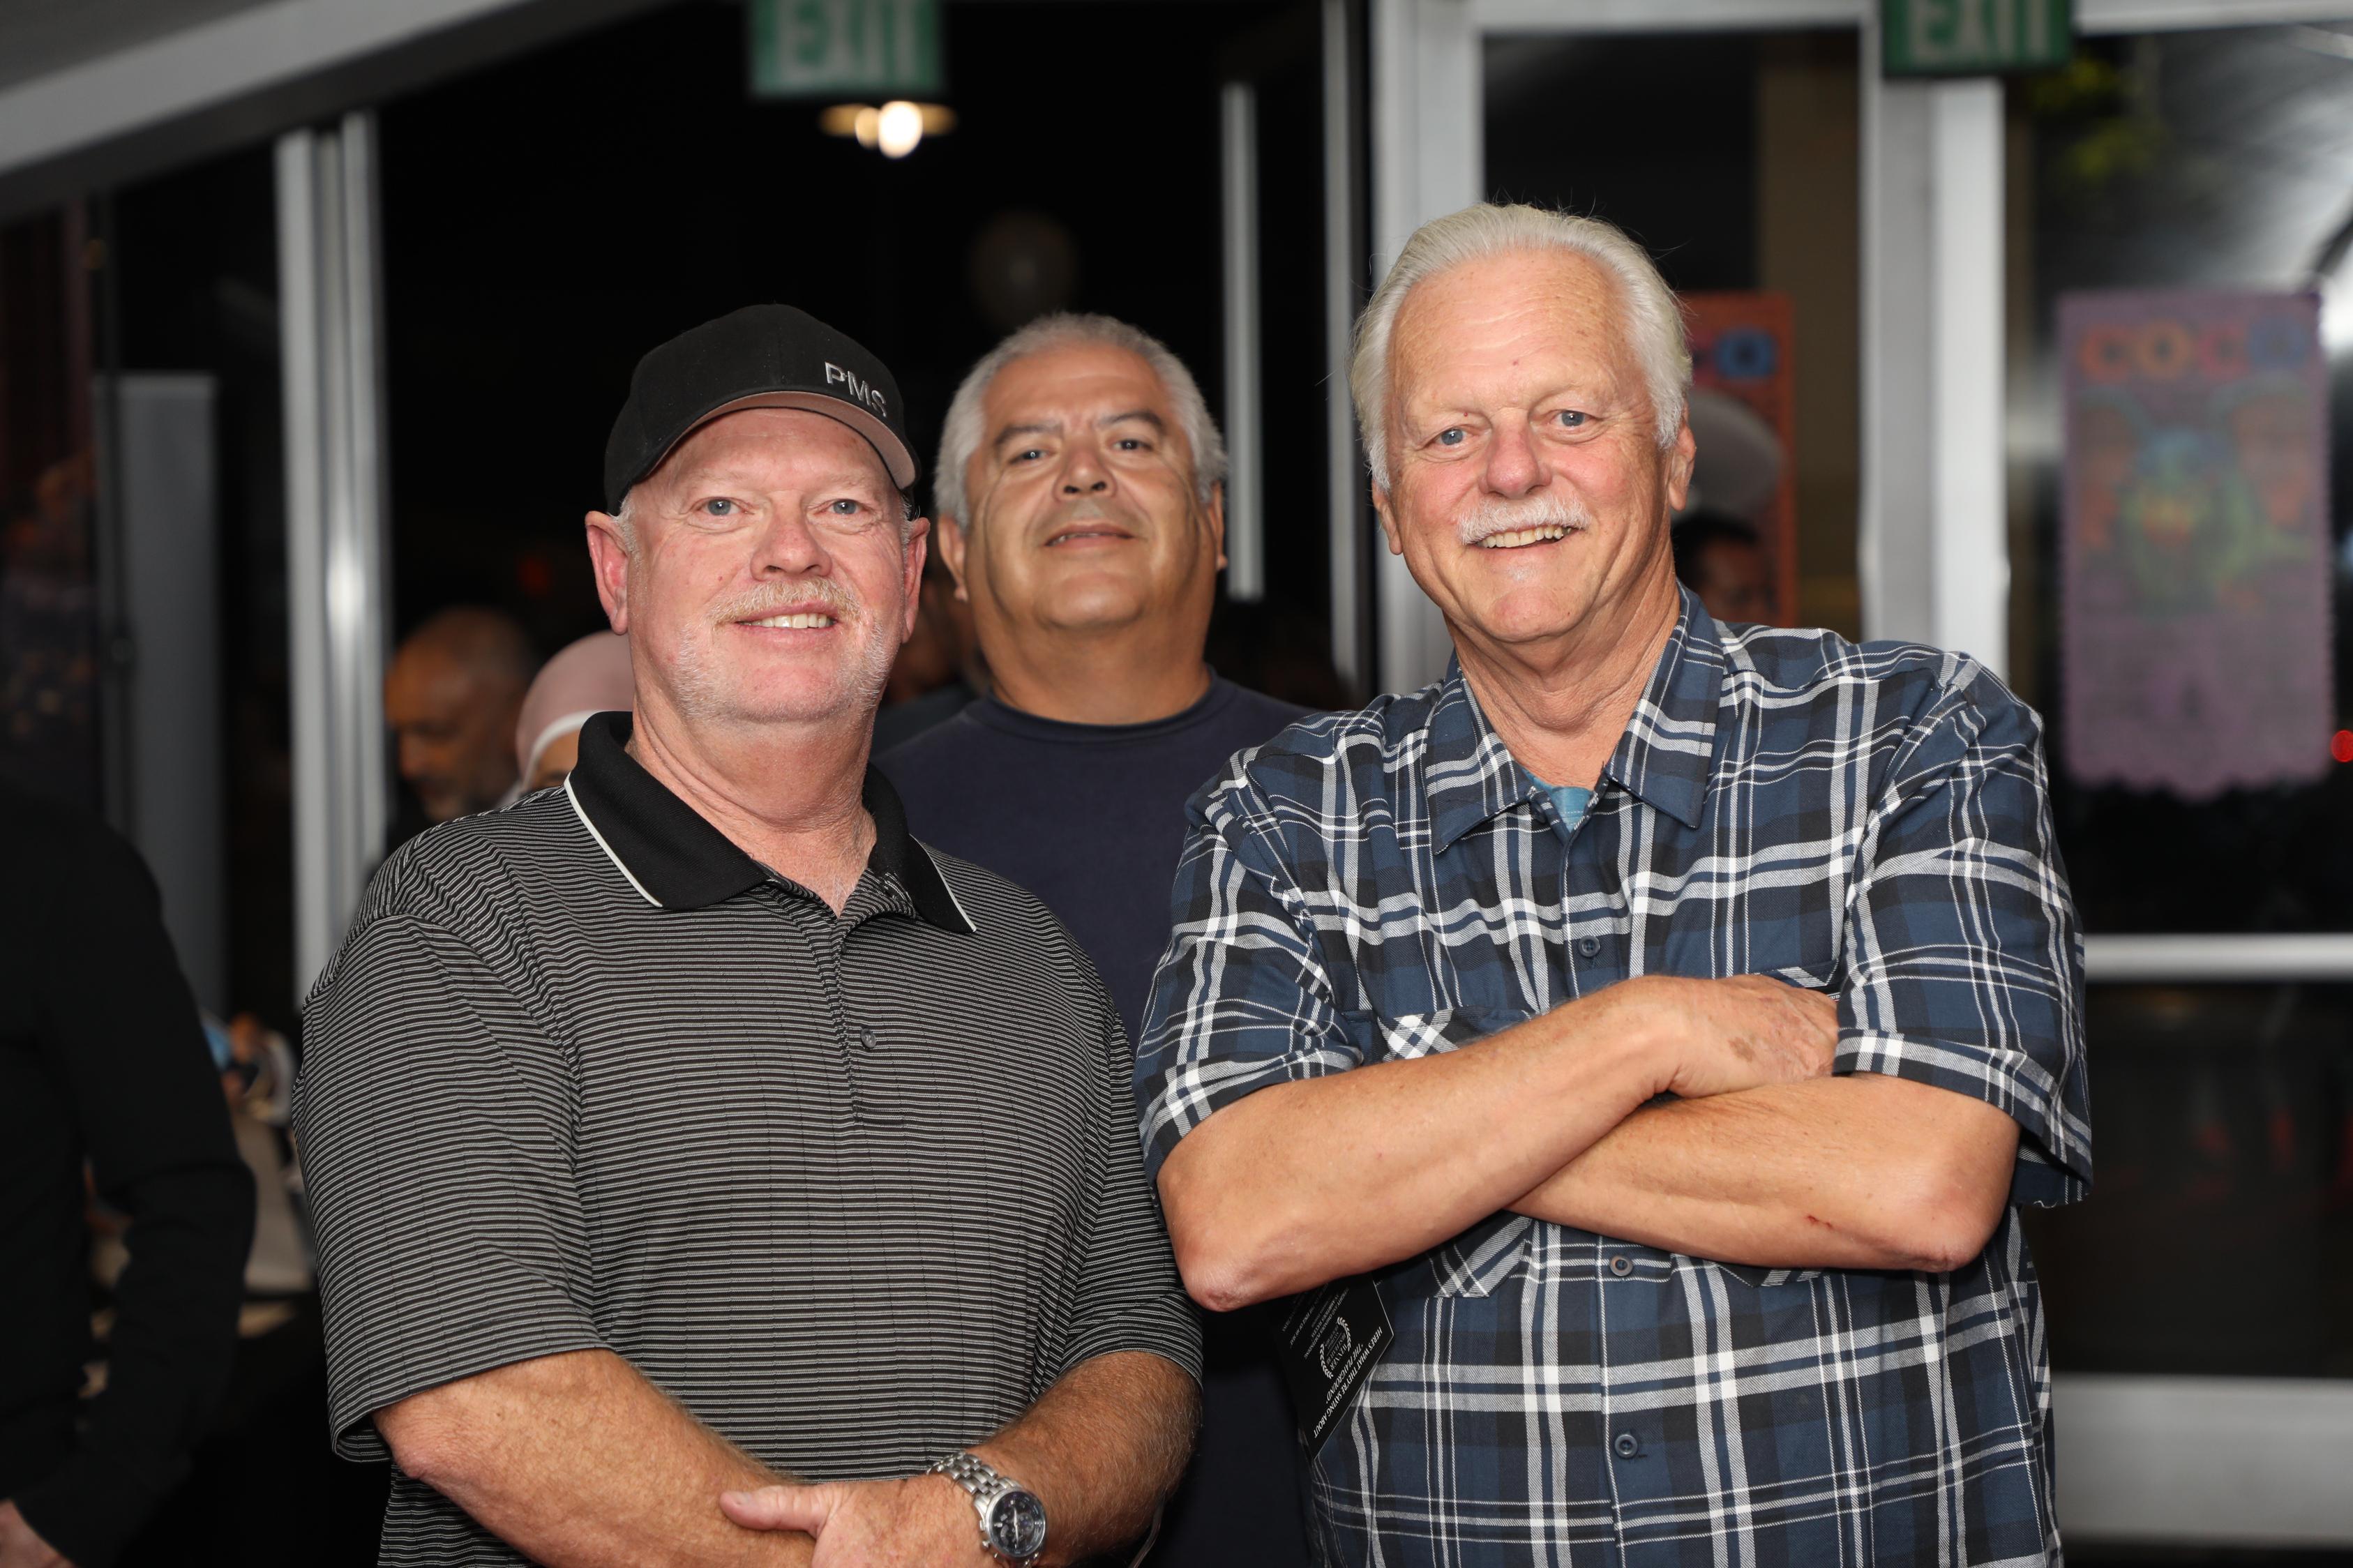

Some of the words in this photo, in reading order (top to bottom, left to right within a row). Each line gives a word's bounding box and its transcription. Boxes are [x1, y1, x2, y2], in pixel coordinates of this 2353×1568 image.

[825, 361, 887, 418] PMS
[1330, 1343, 1347, 1371] WINNER
[1356, 1348, 1369, 1370] WHAT
[1340, 1366, 1358, 1394] THEY'RE
[1326, 1390, 1342, 1417] SAYING
[1313, 1412, 1327, 1438] ABOUT
